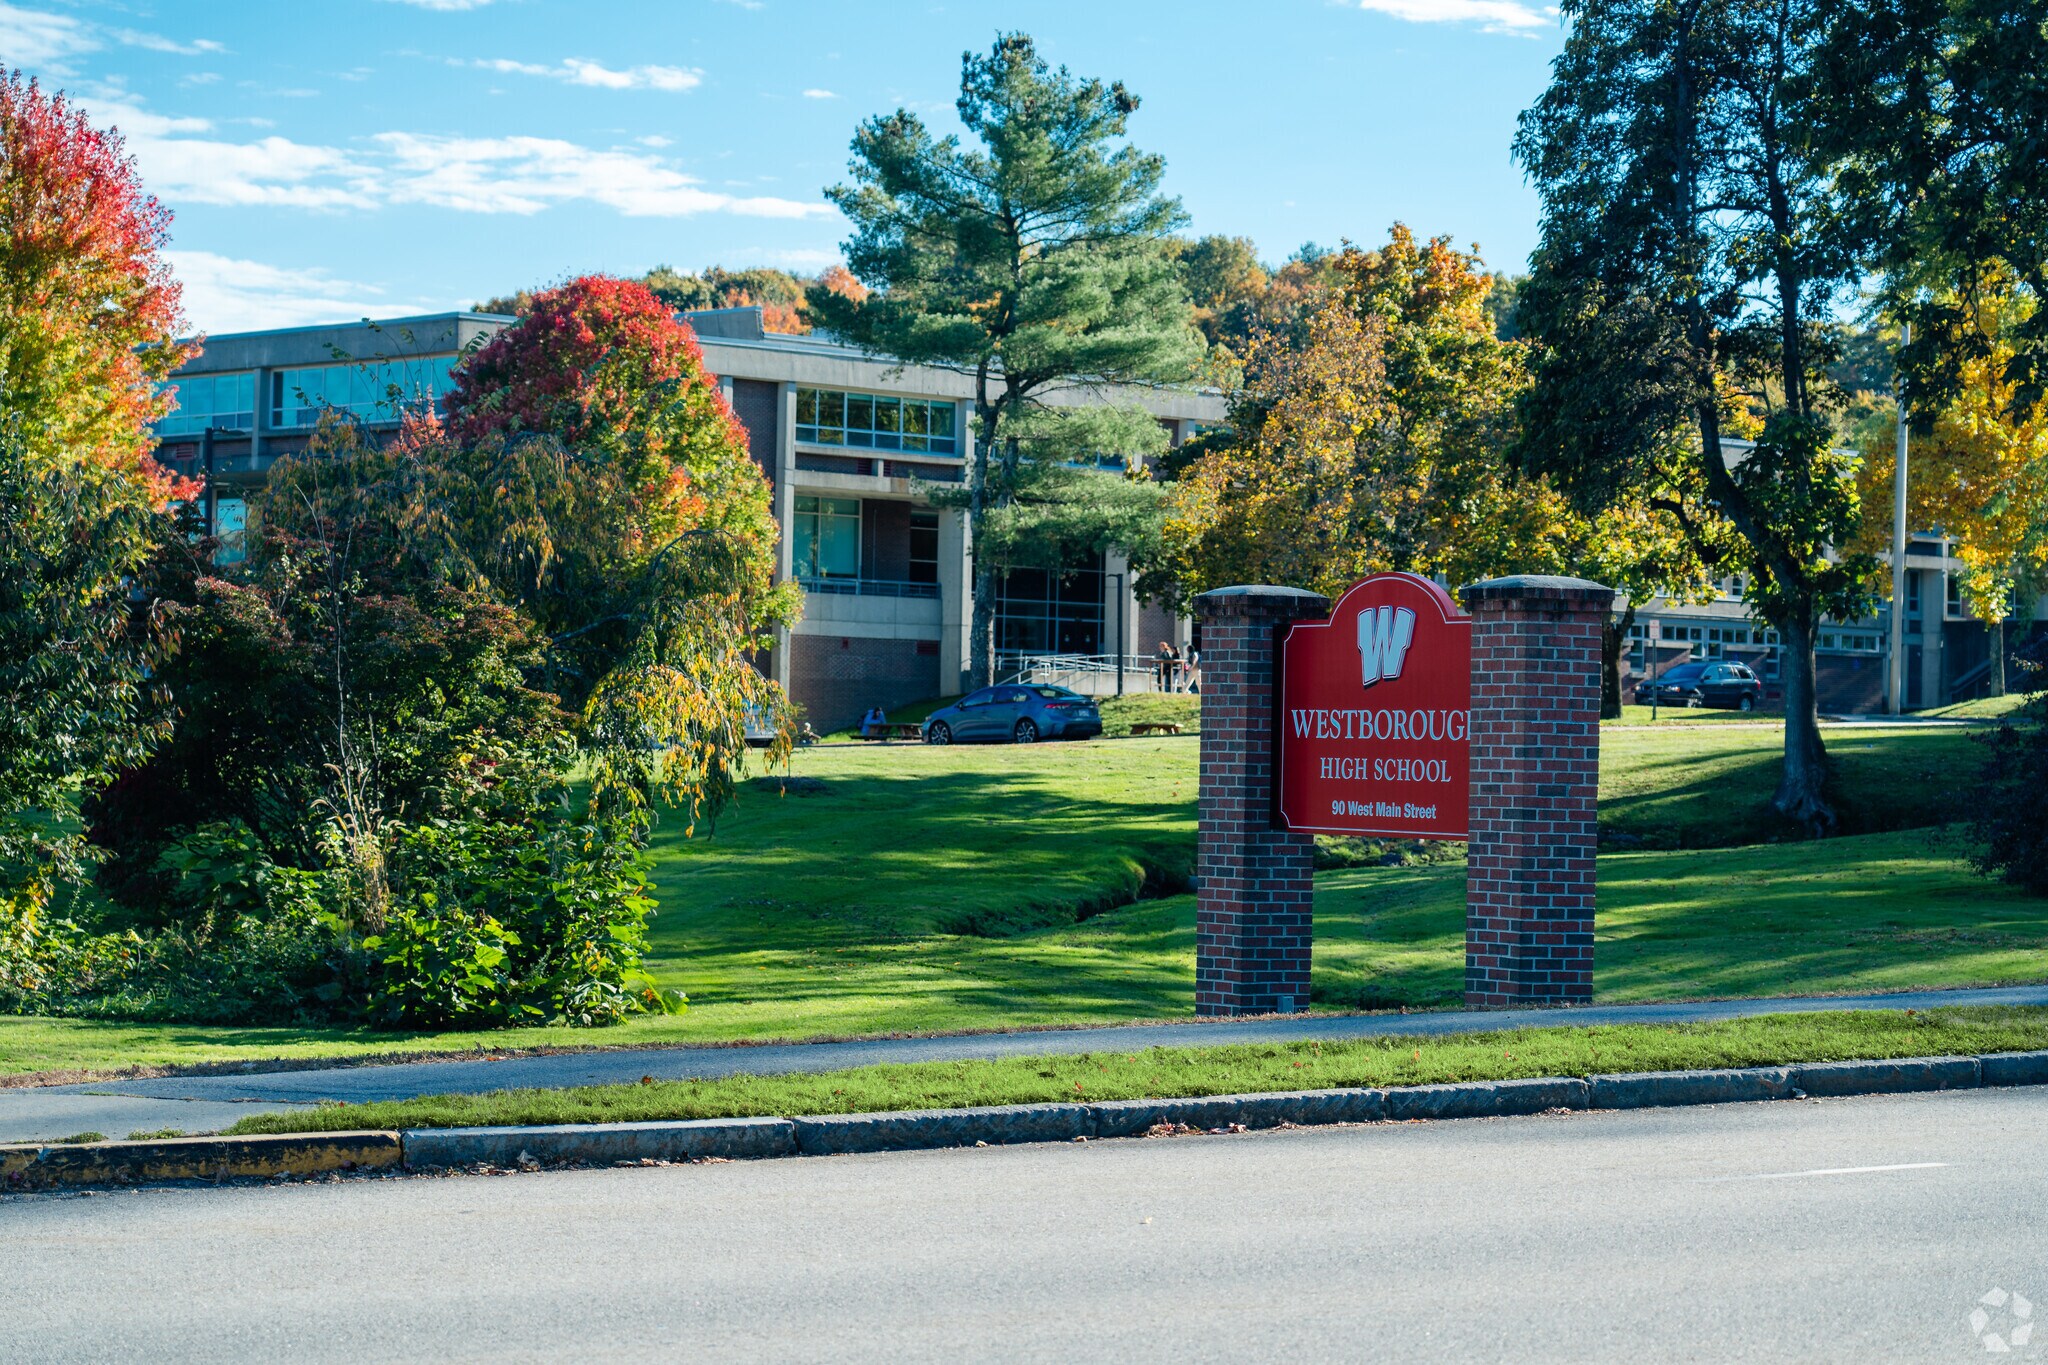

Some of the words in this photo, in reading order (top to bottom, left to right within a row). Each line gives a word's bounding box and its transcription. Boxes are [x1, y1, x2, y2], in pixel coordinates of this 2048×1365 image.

[1357, 605, 1416, 687] W
[1320, 757, 1368, 780] HIGH
[1374, 758, 1452, 782] SCHOOL
[1331, 800, 1346, 816] 90
[1347, 801, 1374, 817] West
[1375, 802, 1402, 818] Main
[1403, 802, 1437, 819] Street
